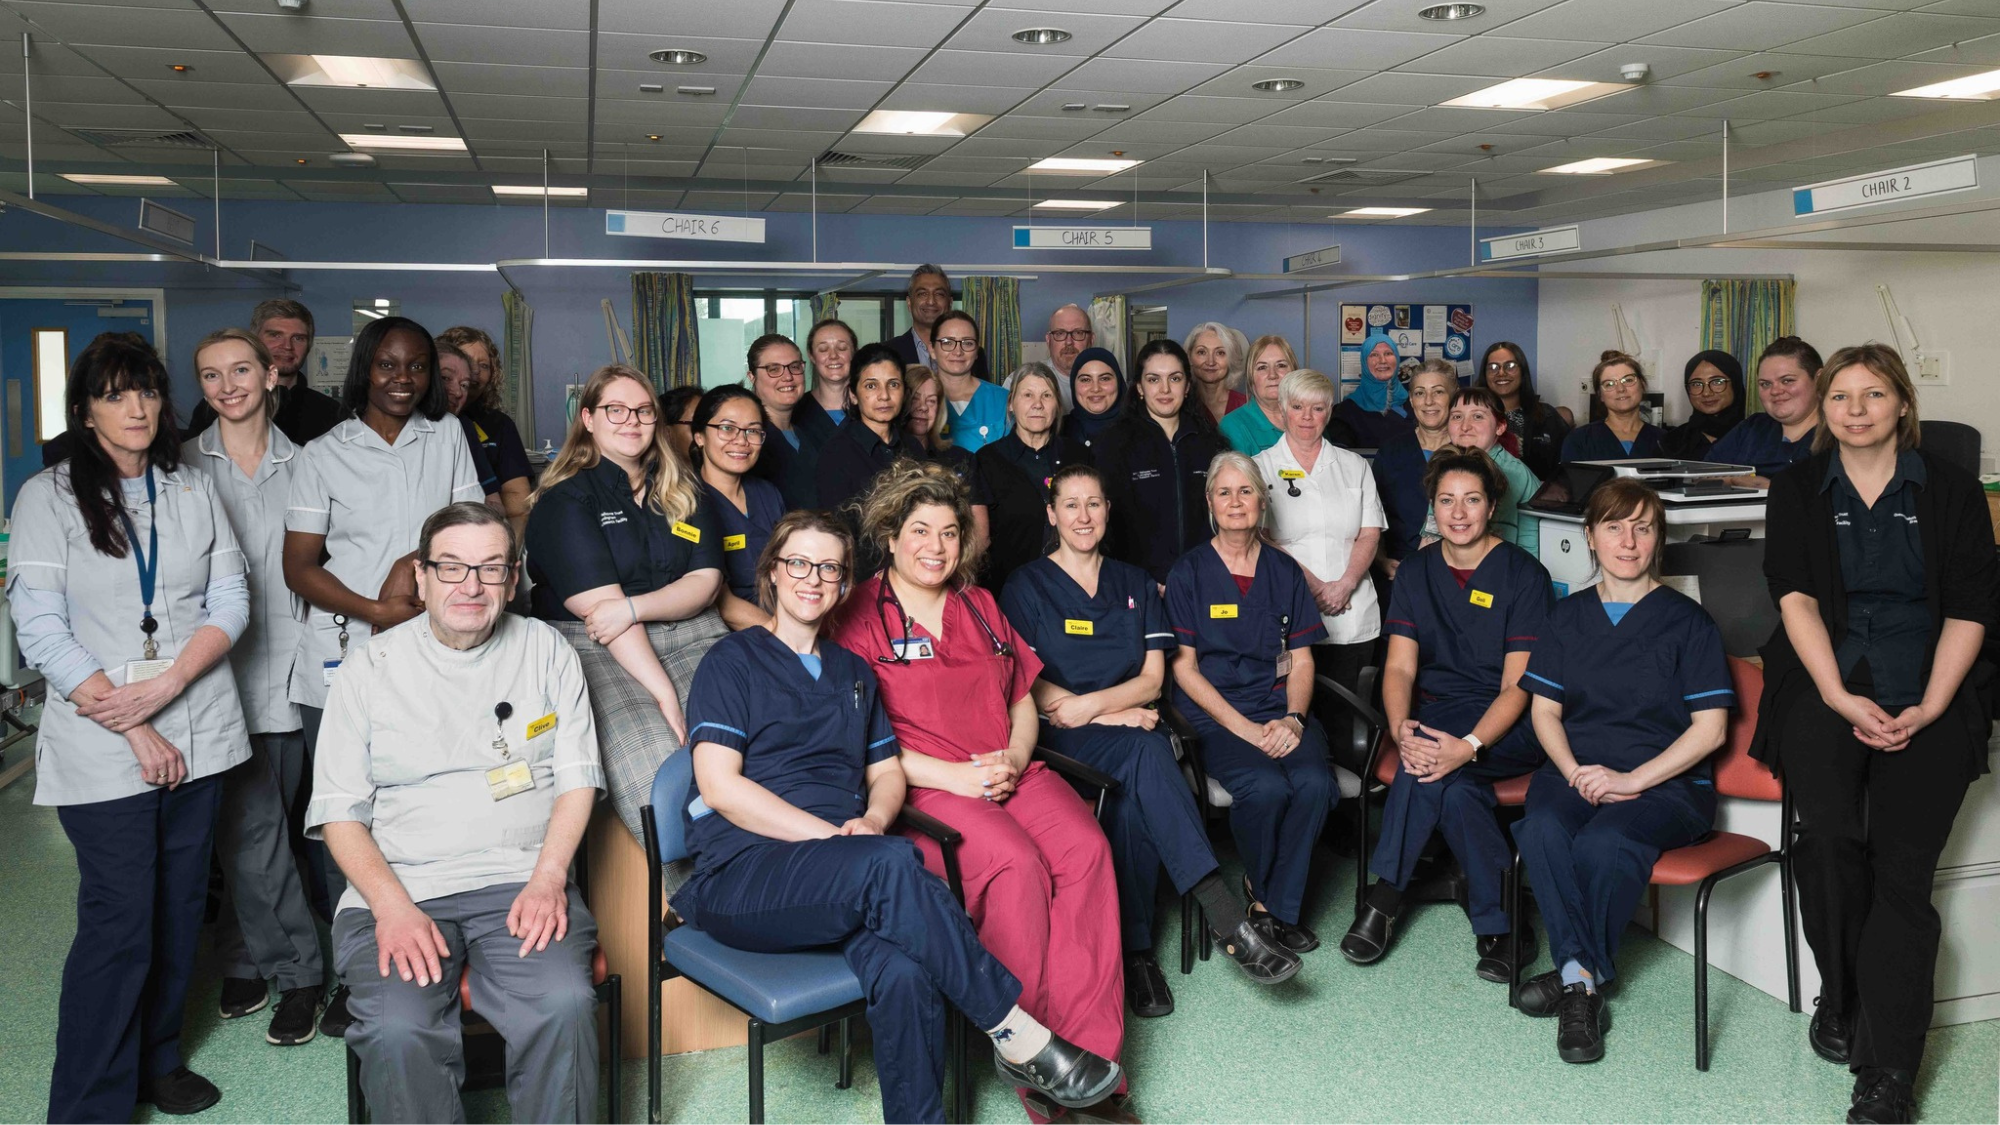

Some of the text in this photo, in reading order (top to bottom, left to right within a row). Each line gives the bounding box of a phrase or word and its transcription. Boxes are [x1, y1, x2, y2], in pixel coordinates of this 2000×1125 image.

[1862, 176, 1912, 198] CHAIR 2
[661, 217, 721, 236] CHAIR 6
[1062, 230, 1114, 246] CHAIR 5
[1515, 236, 1544, 252] CHAIR 3
[533, 721, 550, 733] Clive
